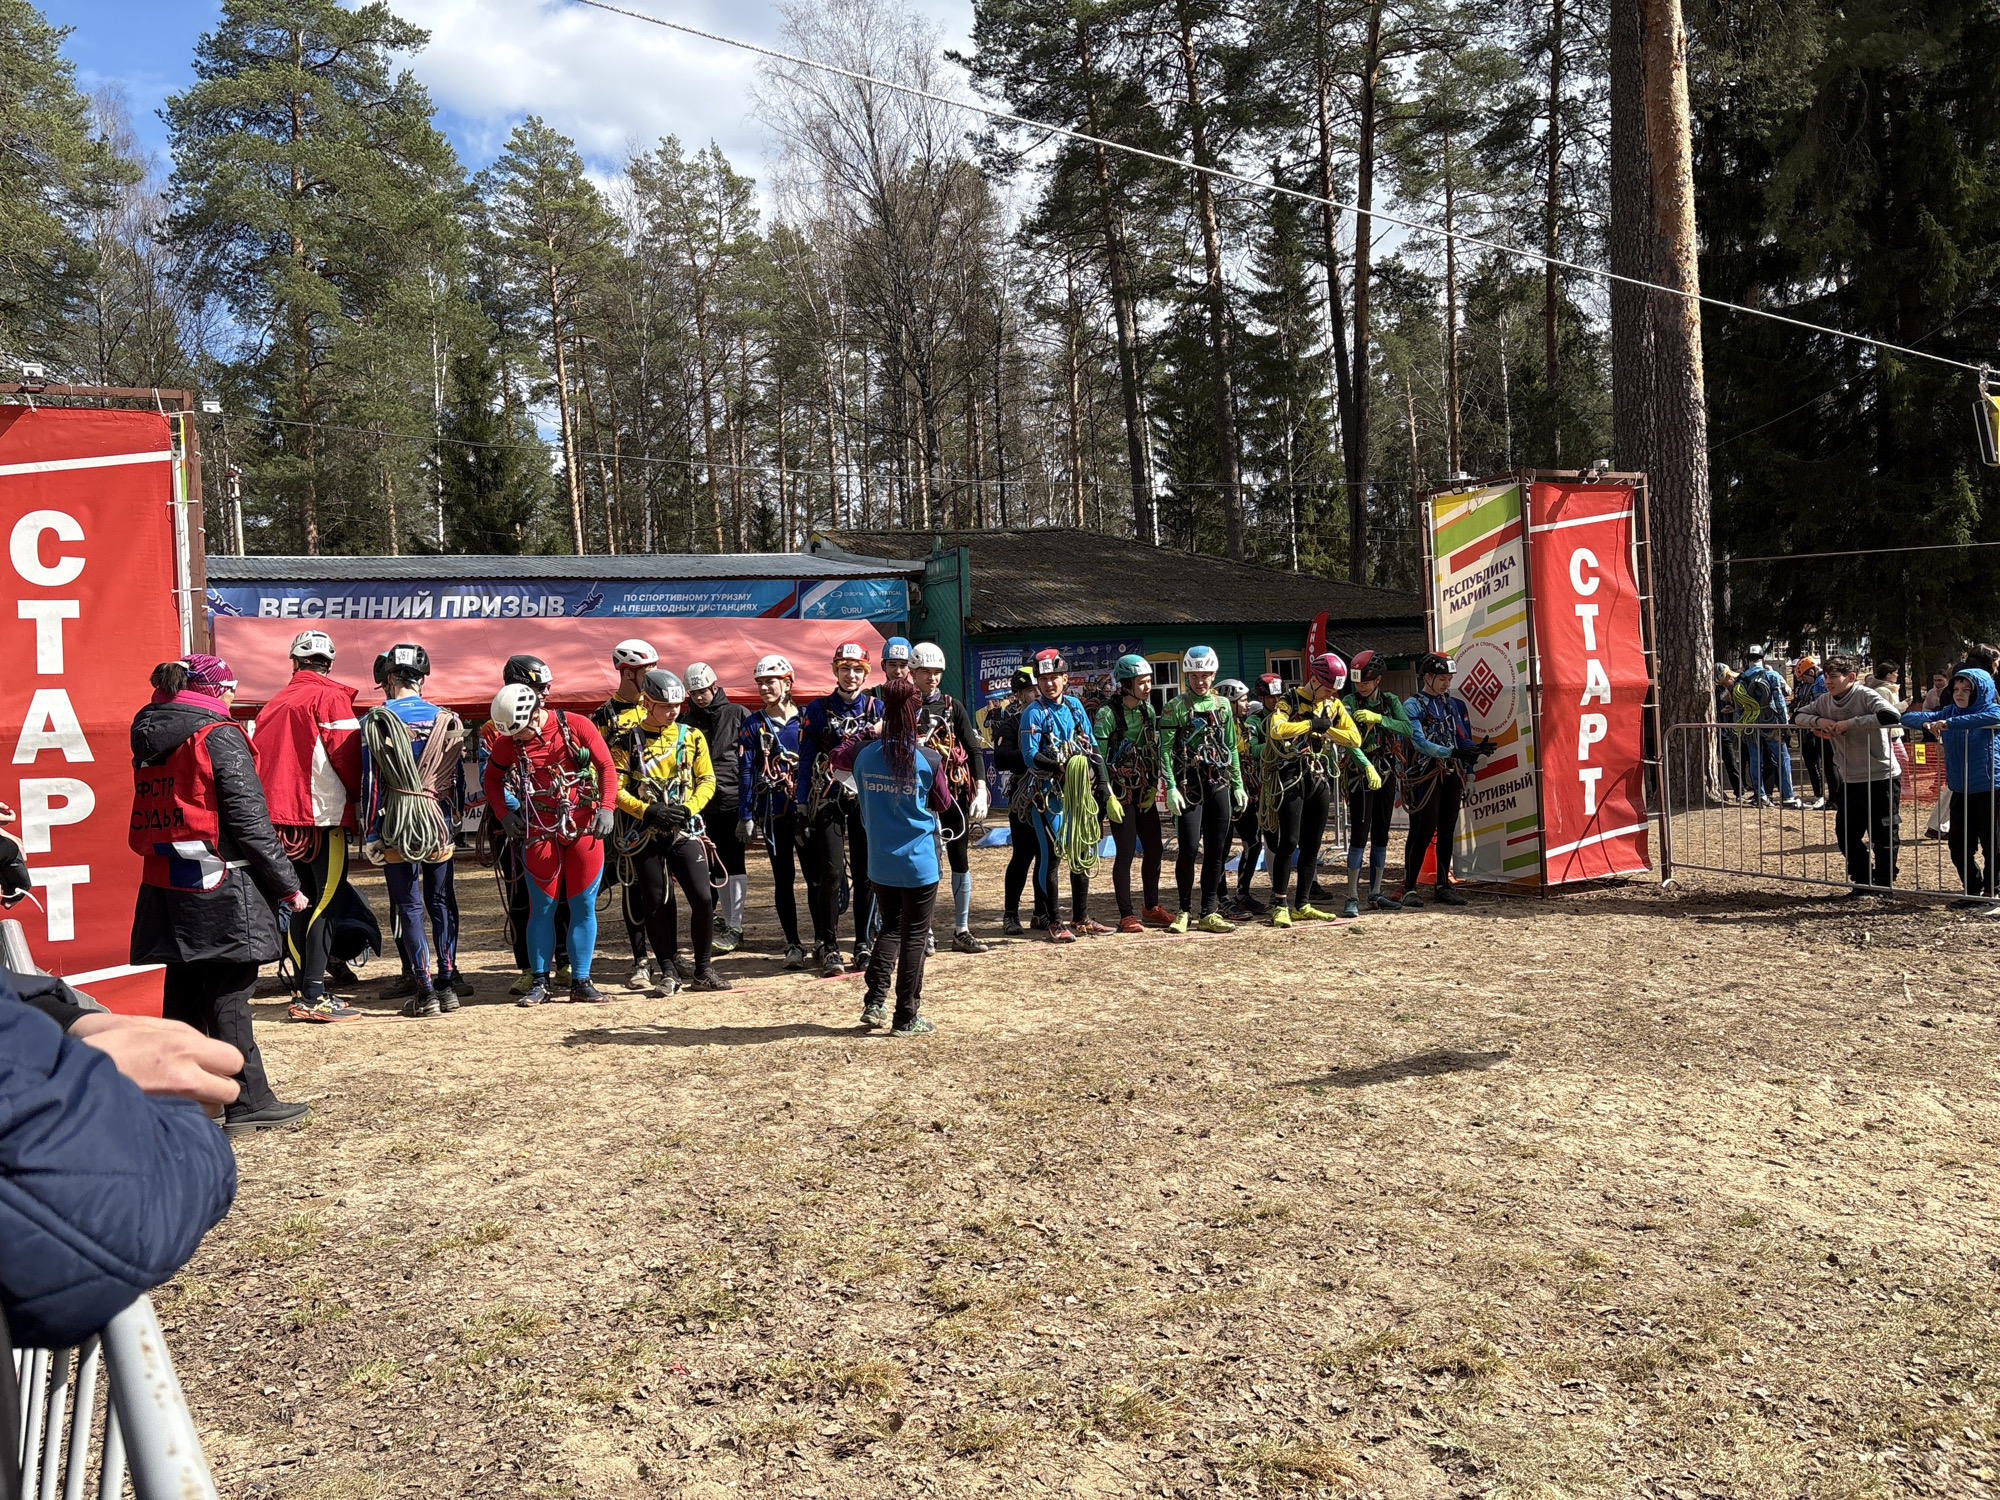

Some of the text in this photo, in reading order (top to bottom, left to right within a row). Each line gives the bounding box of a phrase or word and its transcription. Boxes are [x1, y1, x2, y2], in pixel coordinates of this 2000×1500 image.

[1442, 555, 1517, 602] РЕСПУБЛИКА
[259, 590, 566, 619] ВЕСЕННИЙ ПРИЗЫВ
[623, 593, 752, 602] ПО СПОРТИВНОМУ ТУРИЗМУ
[1450, 574, 1510, 615] МАРИЙ ЭЛ
[613, 603, 758, 613] НА ПЕШЕХОДНЫХ ДИСТАНЦИЯХ
[980, 655, 1023, 669] ВЕСЕННИЙ
[512, 673, 531, 685] VENTO
[1569, 547, 1612, 816] СТАРТ
[9, 508, 96, 943] СТАРТ
[135, 776, 175, 800] ФСТР
[1461, 771, 1534, 809] ОРТИВНЫЙ
[131, 807, 185, 831] СУДЬЯ
[1472, 795, 1518, 821] ТУРИЗМ
